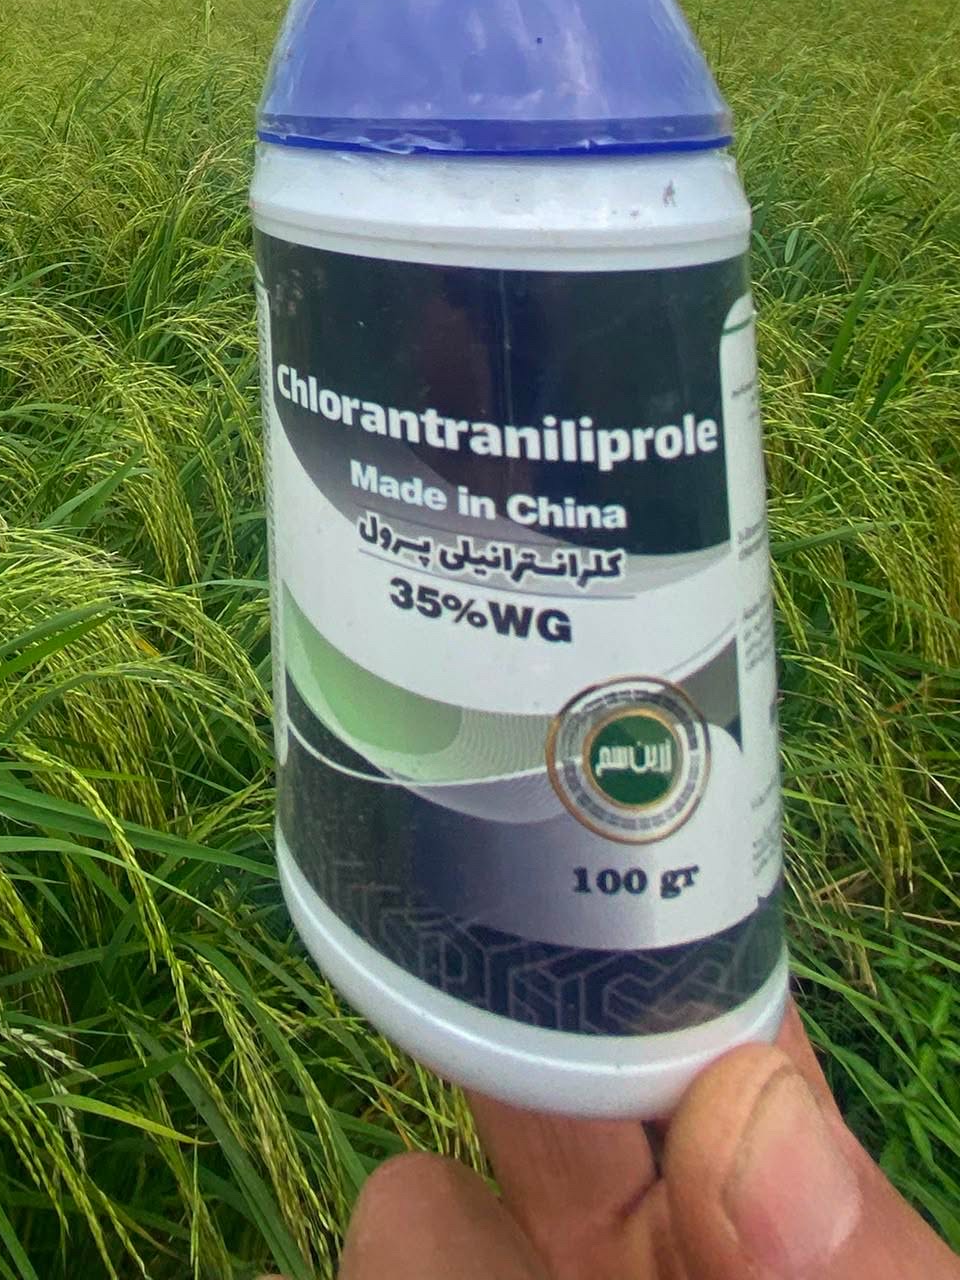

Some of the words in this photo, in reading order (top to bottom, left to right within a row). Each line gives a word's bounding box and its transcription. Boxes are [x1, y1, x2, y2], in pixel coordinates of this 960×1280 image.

[276, 363, 719, 472] Chlorantraniliprole
[349, 458, 448, 511] Made
[457, 485, 497, 521] in
[506, 493, 628, 530] China
[389, 576, 573, 643] 35%WG
[572, 865, 648, 895] 100
[659, 865, 700, 900] gr
